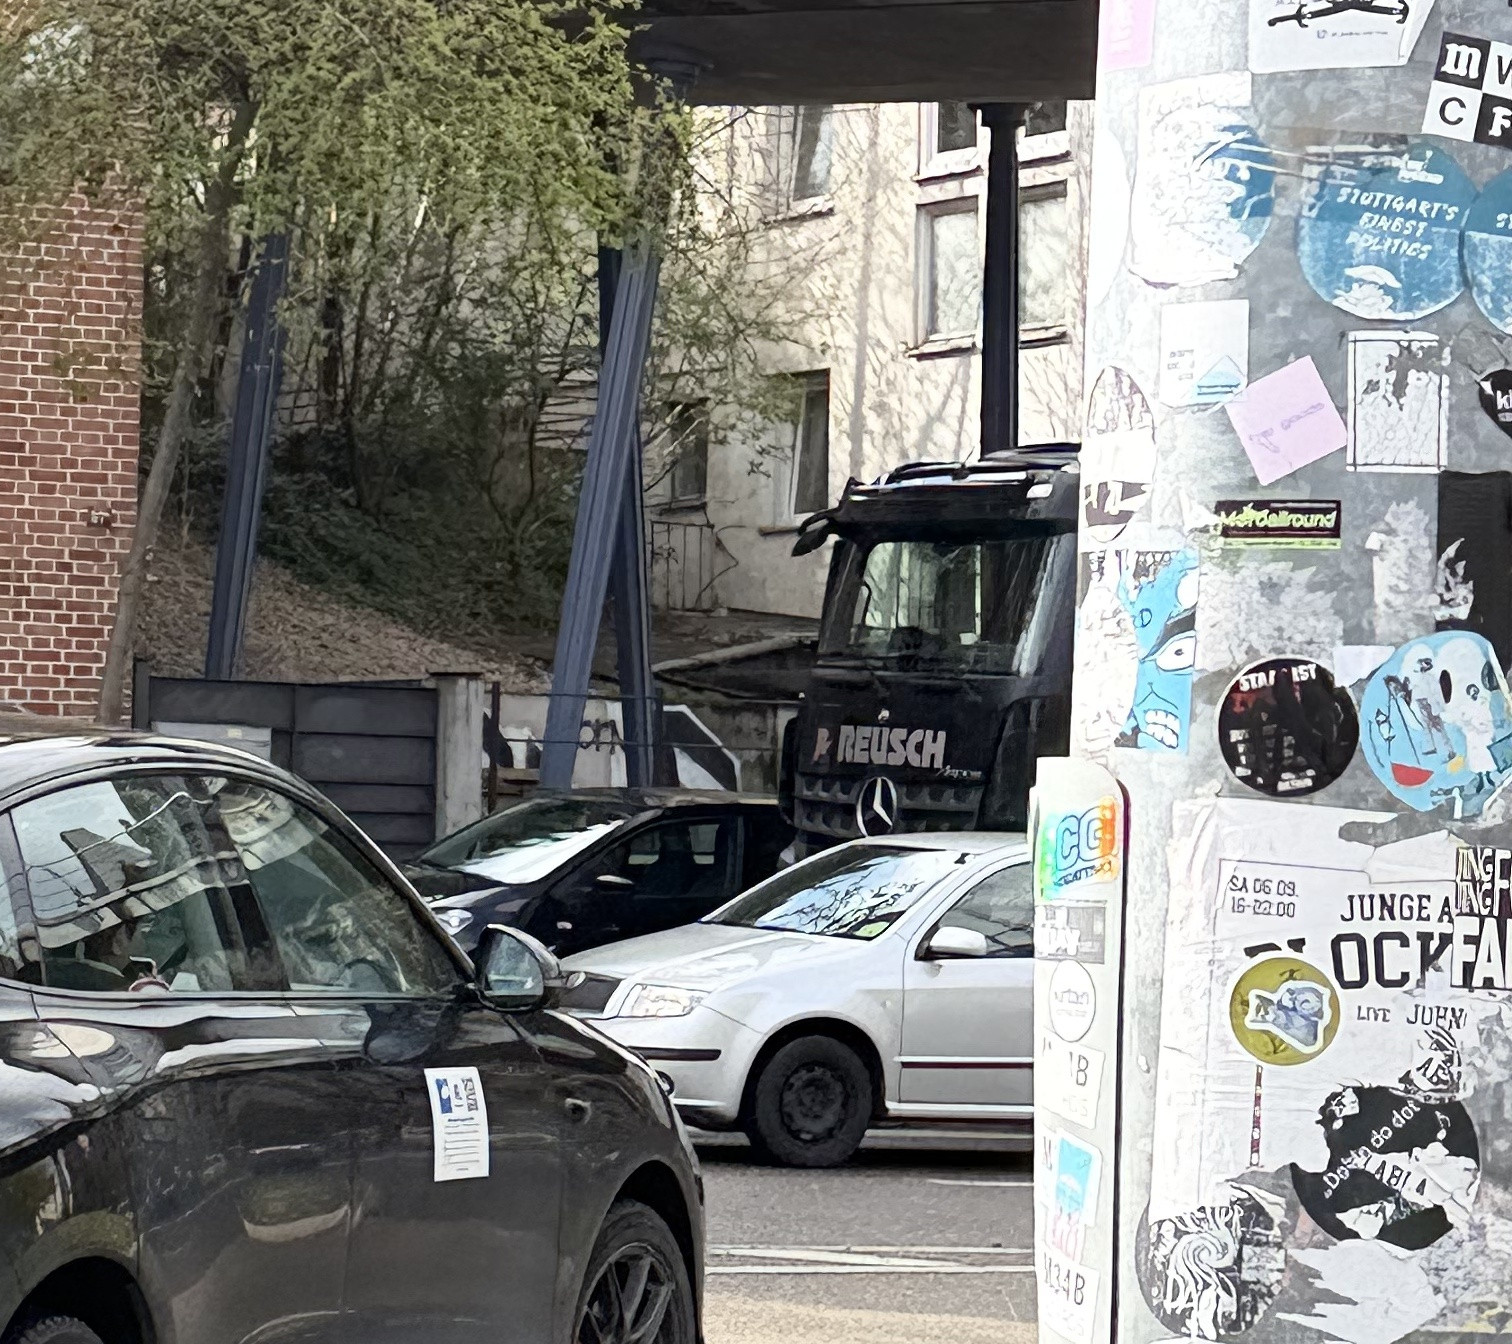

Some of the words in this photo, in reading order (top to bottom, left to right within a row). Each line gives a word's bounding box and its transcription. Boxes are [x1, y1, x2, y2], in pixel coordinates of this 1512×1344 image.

[1337, 187, 1459, 222] STUTTGART'S
[1346, 231, 1432, 260] POLITICS
[838, 725, 946, 768] REUSCH
[1341, 893, 1431, 923] JUNGE
[1437, 896, 1454, 924] A
